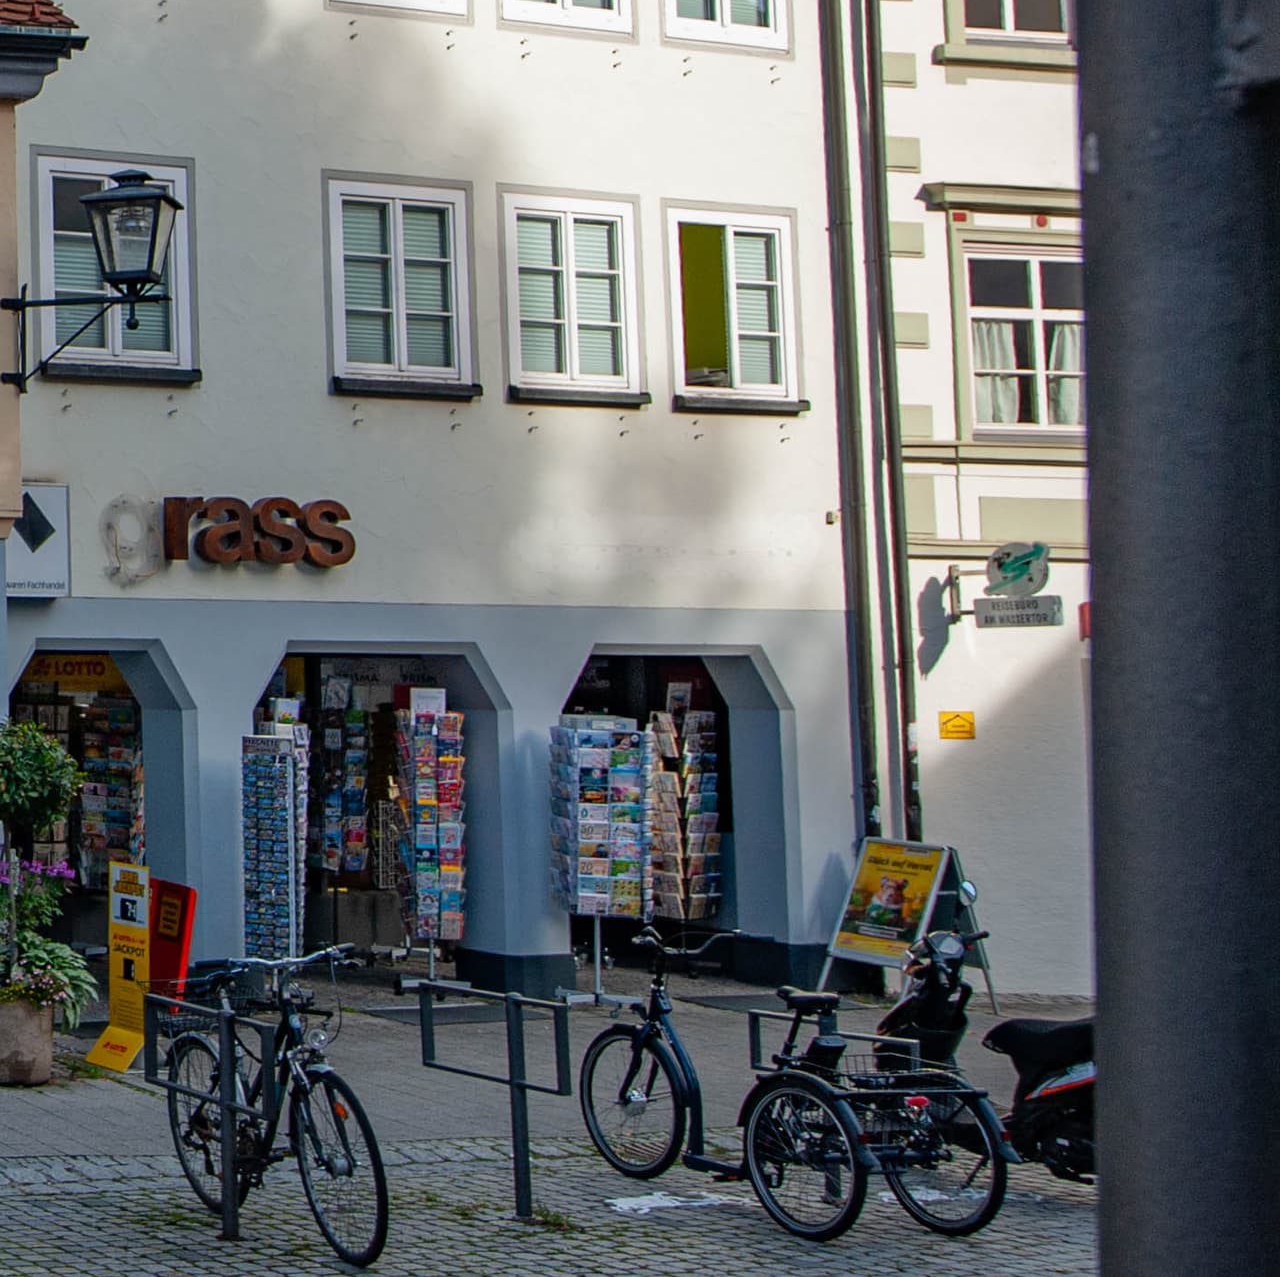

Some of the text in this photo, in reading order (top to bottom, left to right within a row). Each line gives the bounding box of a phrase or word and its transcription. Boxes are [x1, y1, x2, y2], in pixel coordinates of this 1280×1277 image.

[27, 580, 65, 591] Fachhandel
[984, 614, 996, 624] AM
[54, 660, 106, 676] LOTTO
[112, 943, 145, 958] JACKPOT
